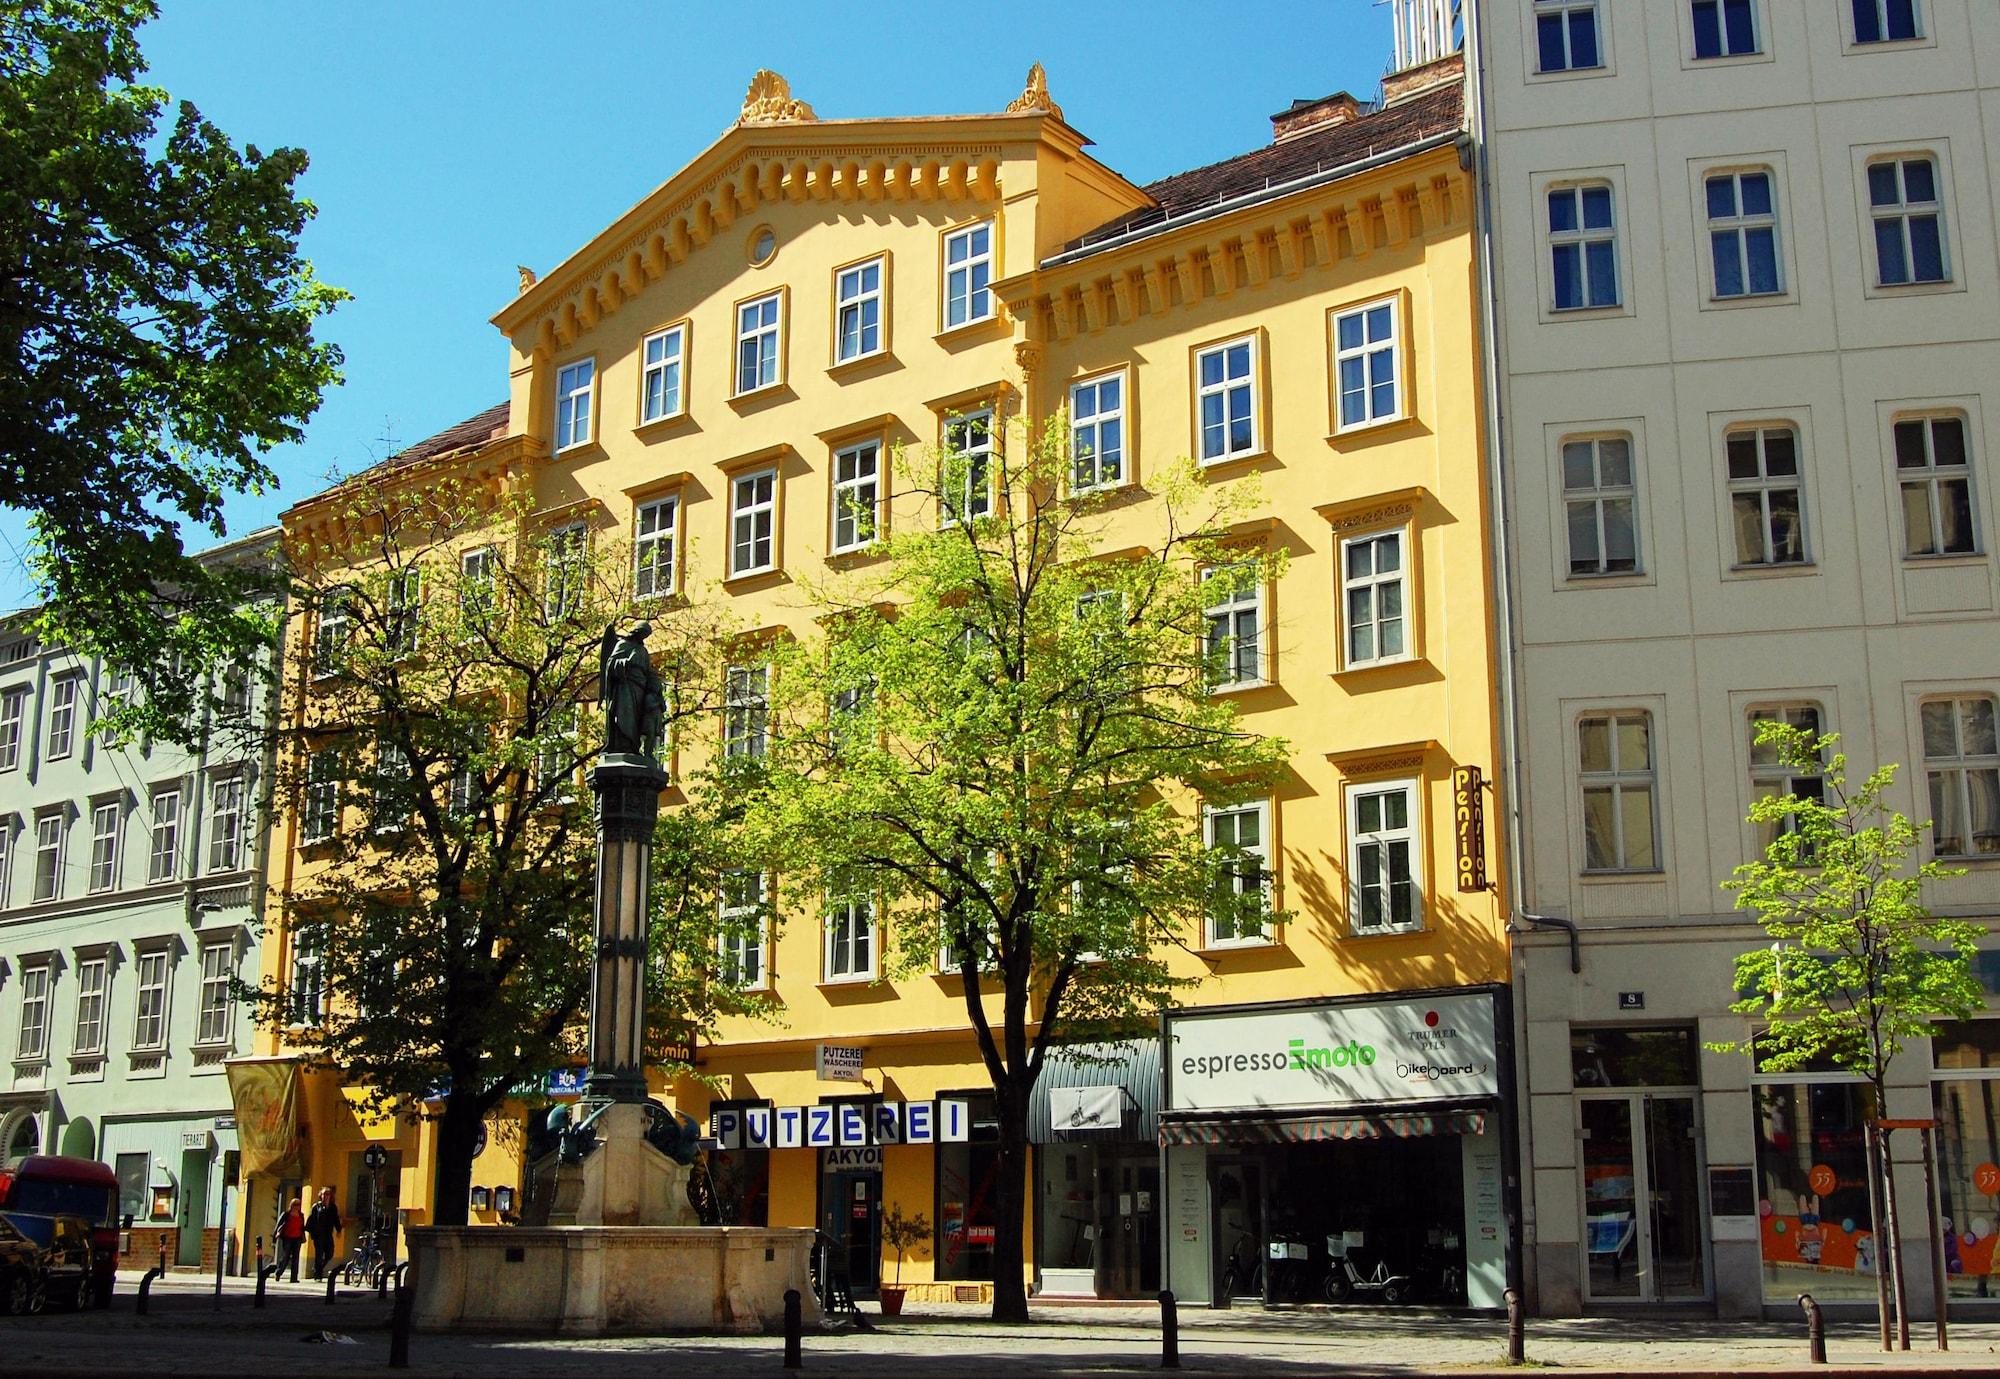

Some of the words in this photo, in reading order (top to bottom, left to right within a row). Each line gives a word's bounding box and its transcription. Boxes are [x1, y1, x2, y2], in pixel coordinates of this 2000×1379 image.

[1628, 994, 1635, 1003] 8
[1408, 1028, 1457, 1040] TRUMER
[1422, 1040, 1446, 1050] PILS
[823, 1046, 864, 1059] PUTZEREI
[833, 1069, 854, 1077] AKYOL
[1396, 1060, 1473, 1080] bikeboard
[719, 1104, 958, 1145] PUTZEREI
